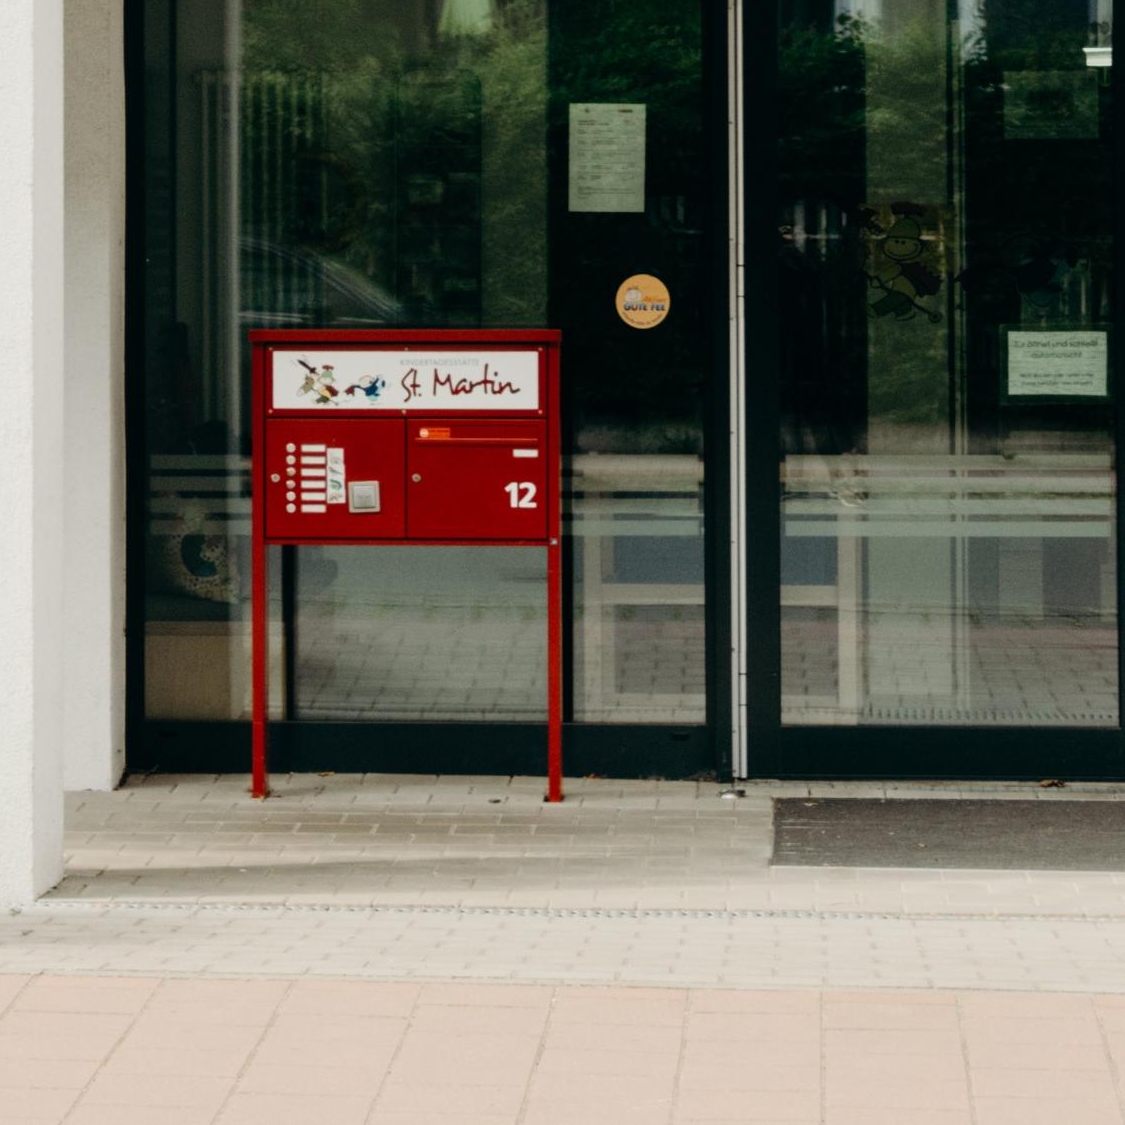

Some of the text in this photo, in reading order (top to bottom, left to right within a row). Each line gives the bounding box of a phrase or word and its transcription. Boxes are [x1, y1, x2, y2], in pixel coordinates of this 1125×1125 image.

[401, 363, 521, 402] St. Martin
[504, 481, 537, 508] 12
